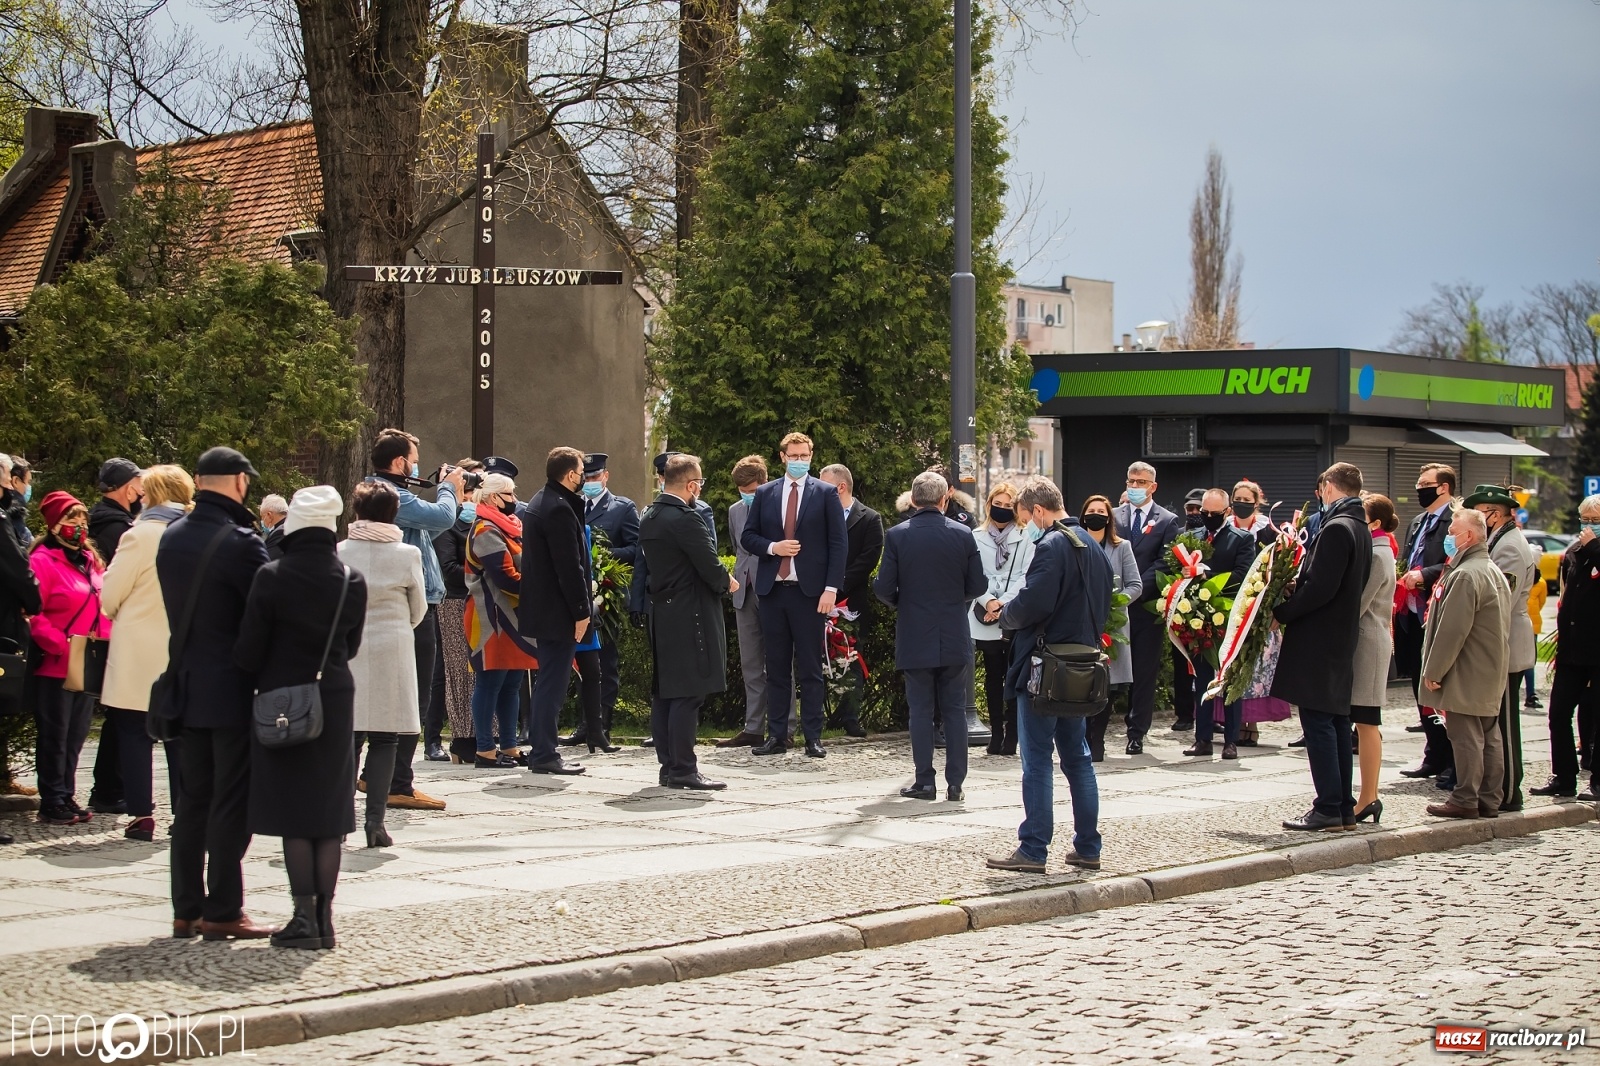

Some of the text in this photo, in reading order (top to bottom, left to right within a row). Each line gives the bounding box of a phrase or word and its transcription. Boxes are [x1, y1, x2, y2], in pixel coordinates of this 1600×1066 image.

[482, 163, 493, 244] 1205
[374, 265, 437, 283] KRZYŻ
[480, 308, 491, 389] 2005
[1225, 367, 1311, 394] RUCH
[1518, 383, 1553, 409] RUCH
[1588, 478, 1598, 497] P
